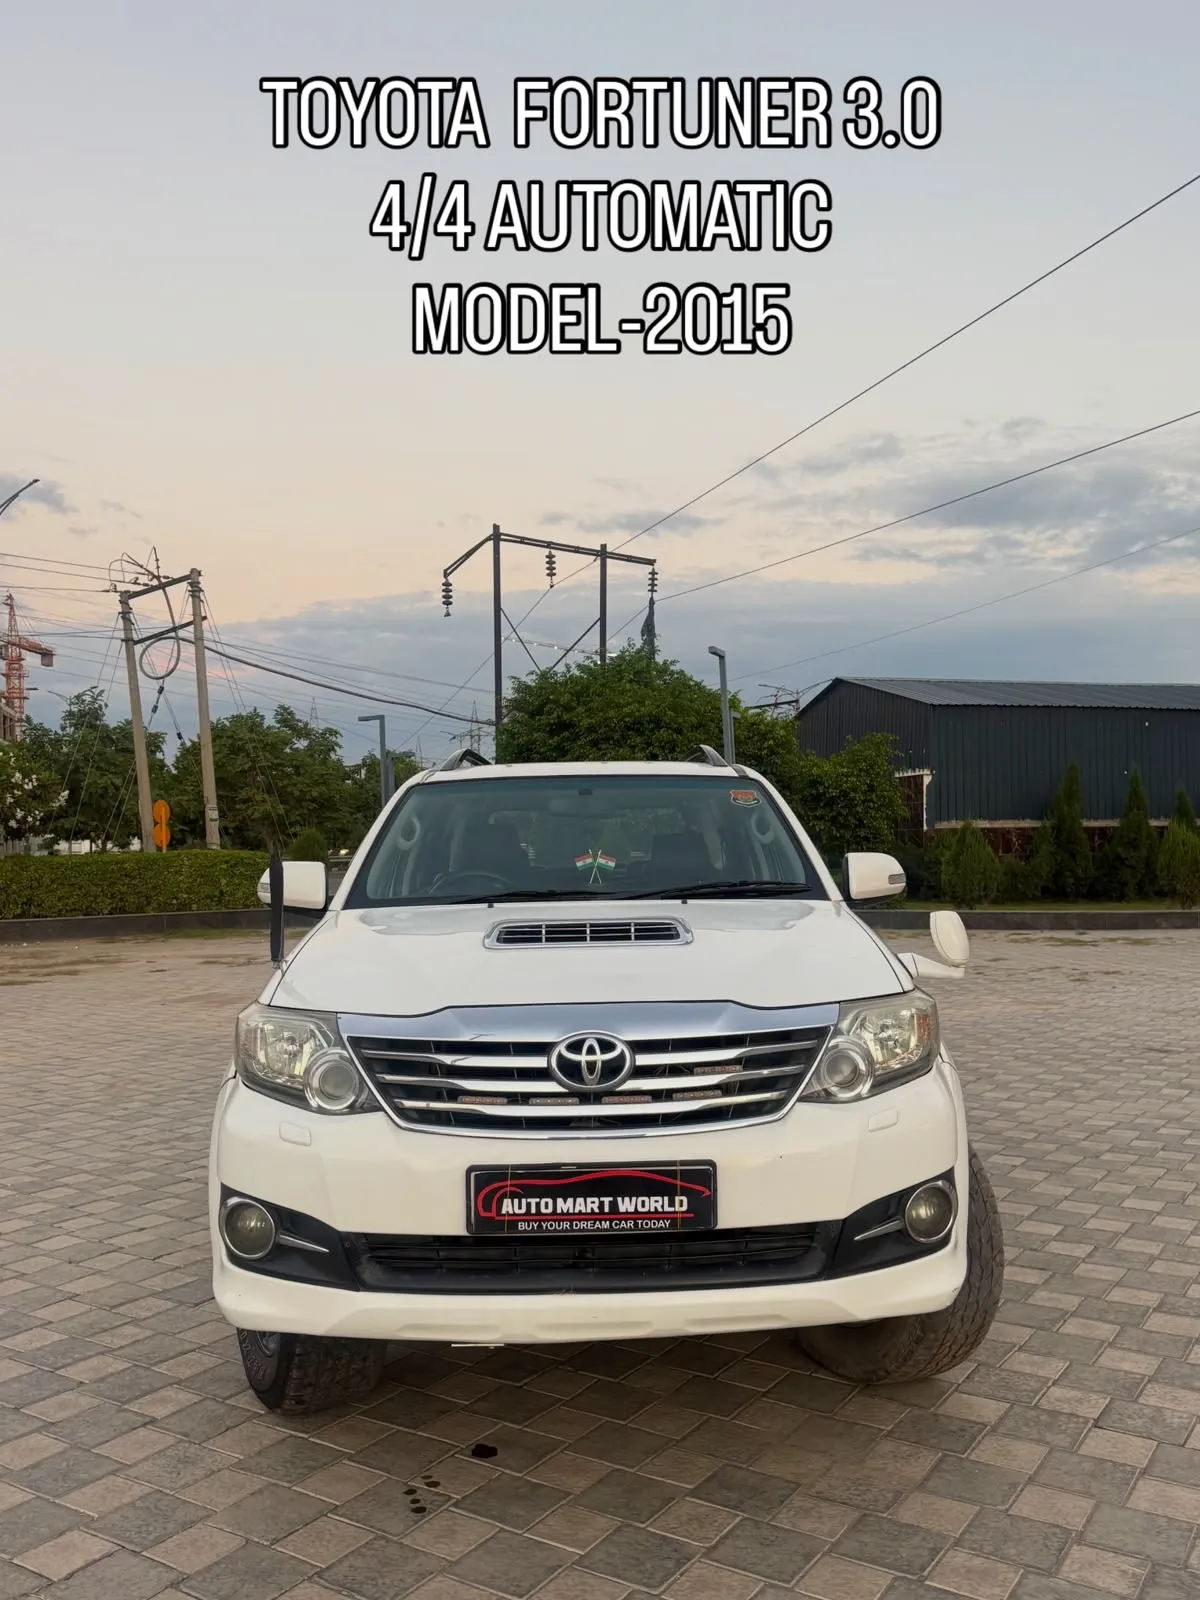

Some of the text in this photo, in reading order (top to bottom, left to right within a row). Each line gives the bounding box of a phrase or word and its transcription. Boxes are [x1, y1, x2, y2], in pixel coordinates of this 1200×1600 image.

[501, 1196, 688, 1214] AUTO MART WORLD
[518, 1219, 671, 1230] BUY YOUR DREAM CAR TODAY
